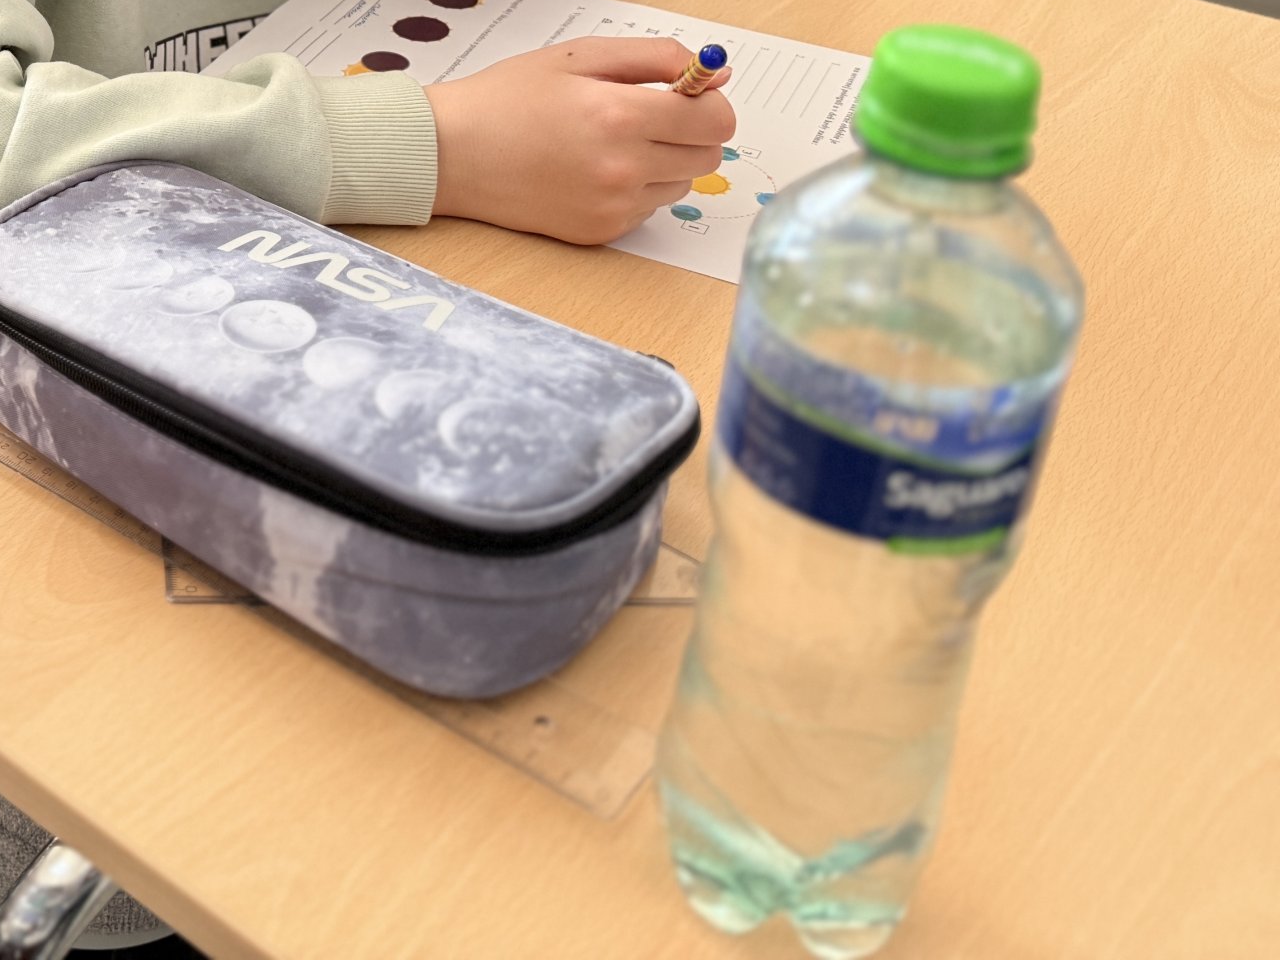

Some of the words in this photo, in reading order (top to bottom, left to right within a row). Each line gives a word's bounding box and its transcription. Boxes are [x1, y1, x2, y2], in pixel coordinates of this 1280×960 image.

[217, 230, 456, 332] NASA
[16, 450, 38, 465] 20
[41, 467, 56, 478] 19
